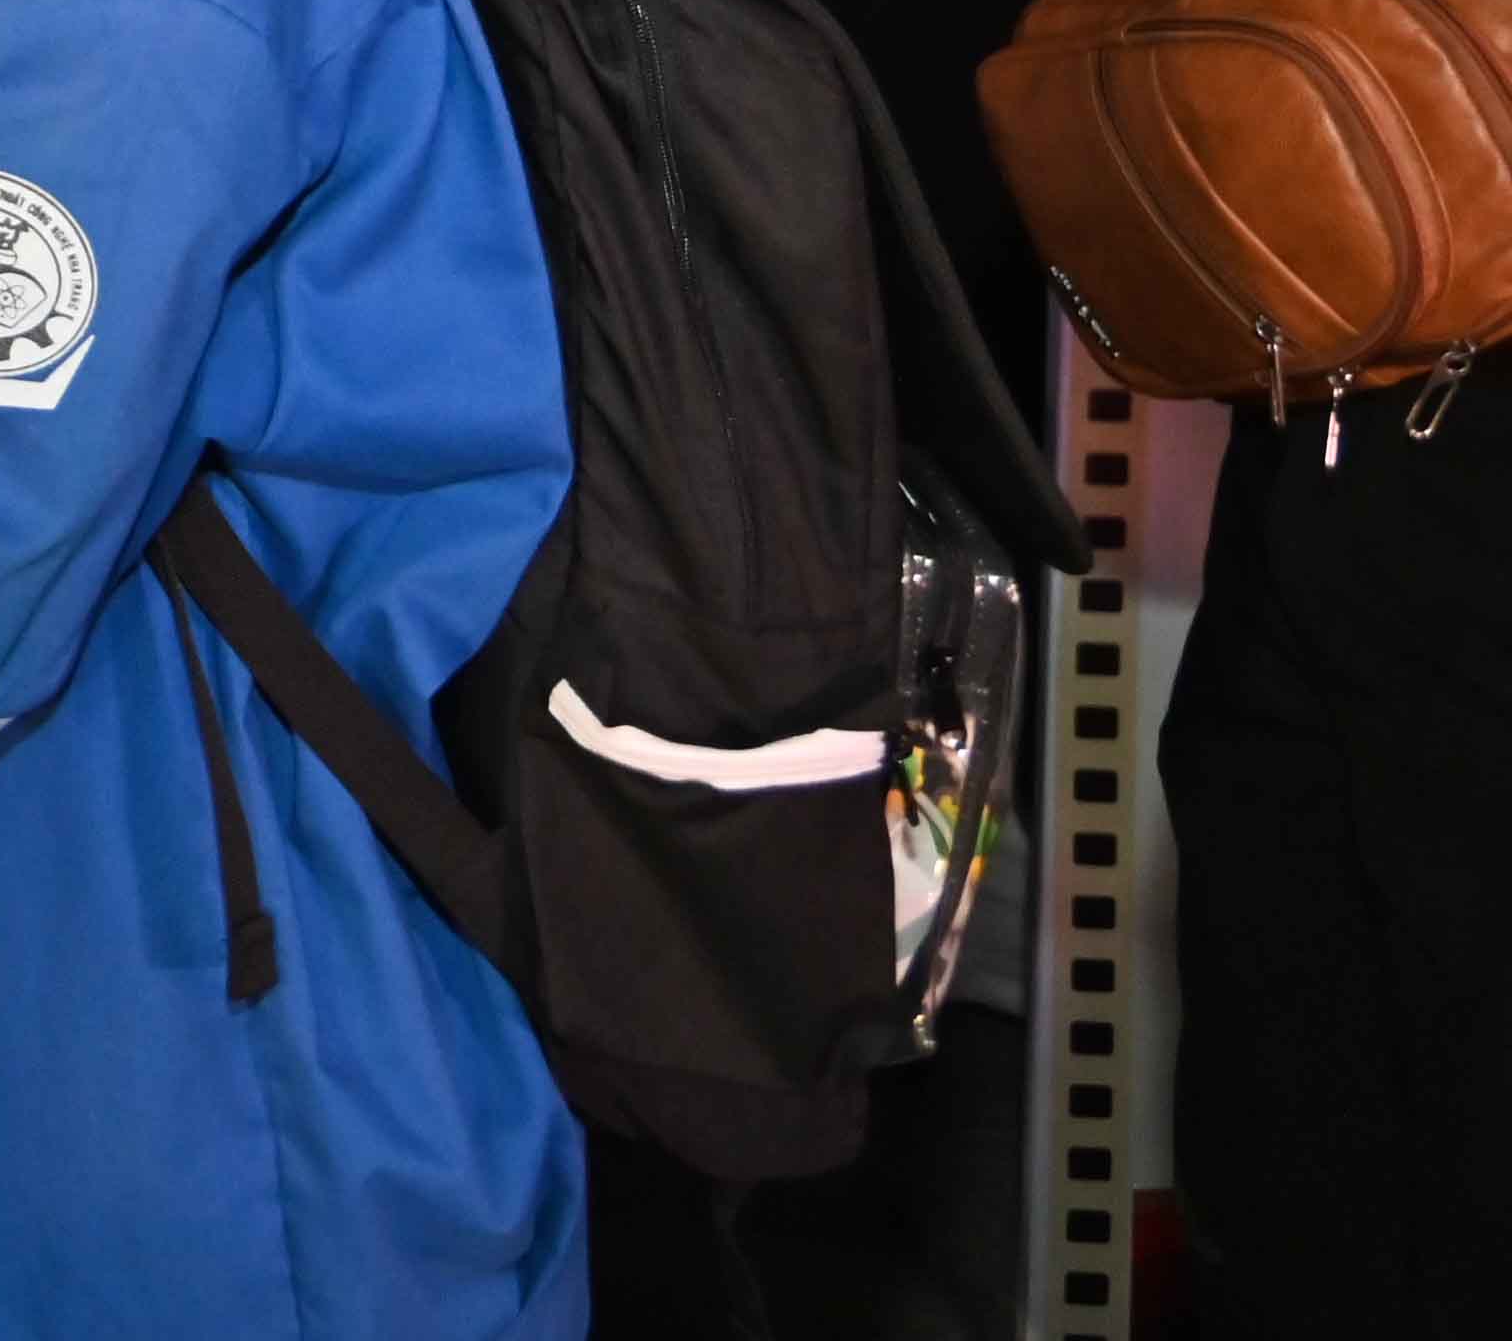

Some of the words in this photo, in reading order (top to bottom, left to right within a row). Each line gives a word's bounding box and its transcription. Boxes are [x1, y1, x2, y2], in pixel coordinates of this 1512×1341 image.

[27, 203, 52, 226] CÔNG
[67, 253, 81, 274] NHA
[67, 278, 83, 311] TRANG
